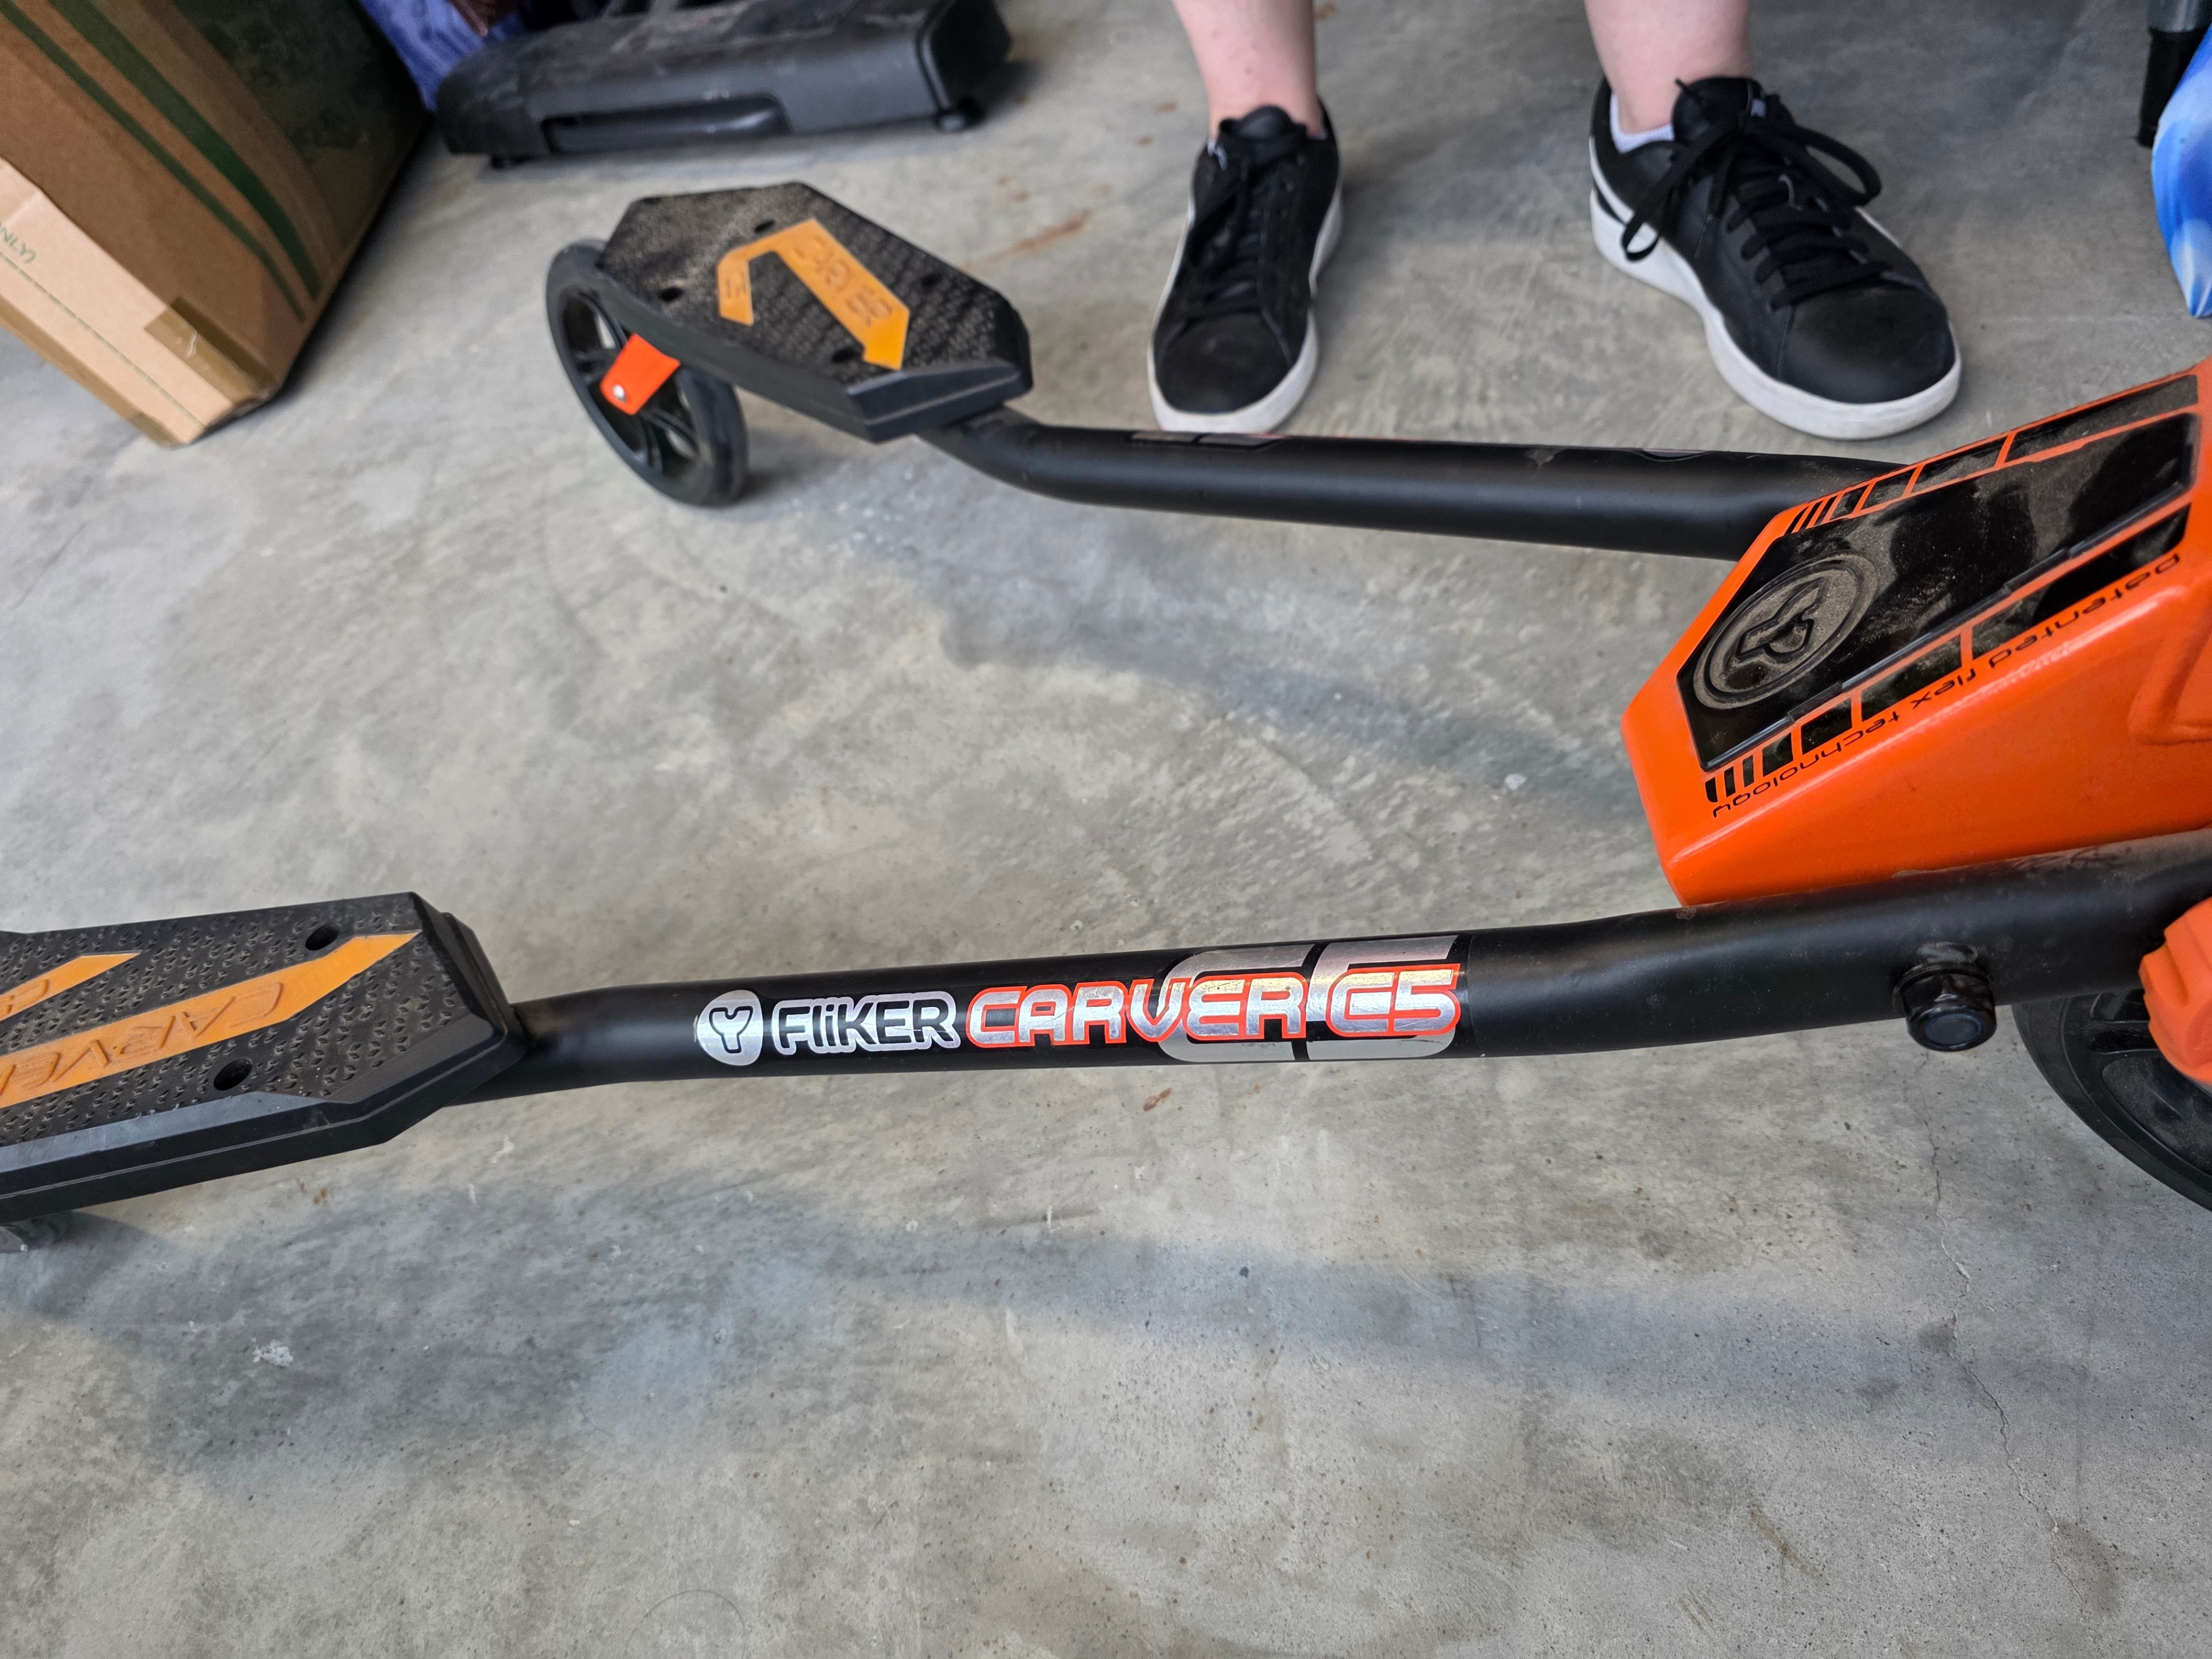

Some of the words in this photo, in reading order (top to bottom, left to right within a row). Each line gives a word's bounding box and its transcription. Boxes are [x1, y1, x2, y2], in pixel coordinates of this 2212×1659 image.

[1988, 552, 2180, 669] patented
[1909, 667, 1977, 710] flex
[1711, 711, 1901, 818] technology
[965, 972, 1307, 1048] CARVER
[1325, 963, 1461, 1037] C5
